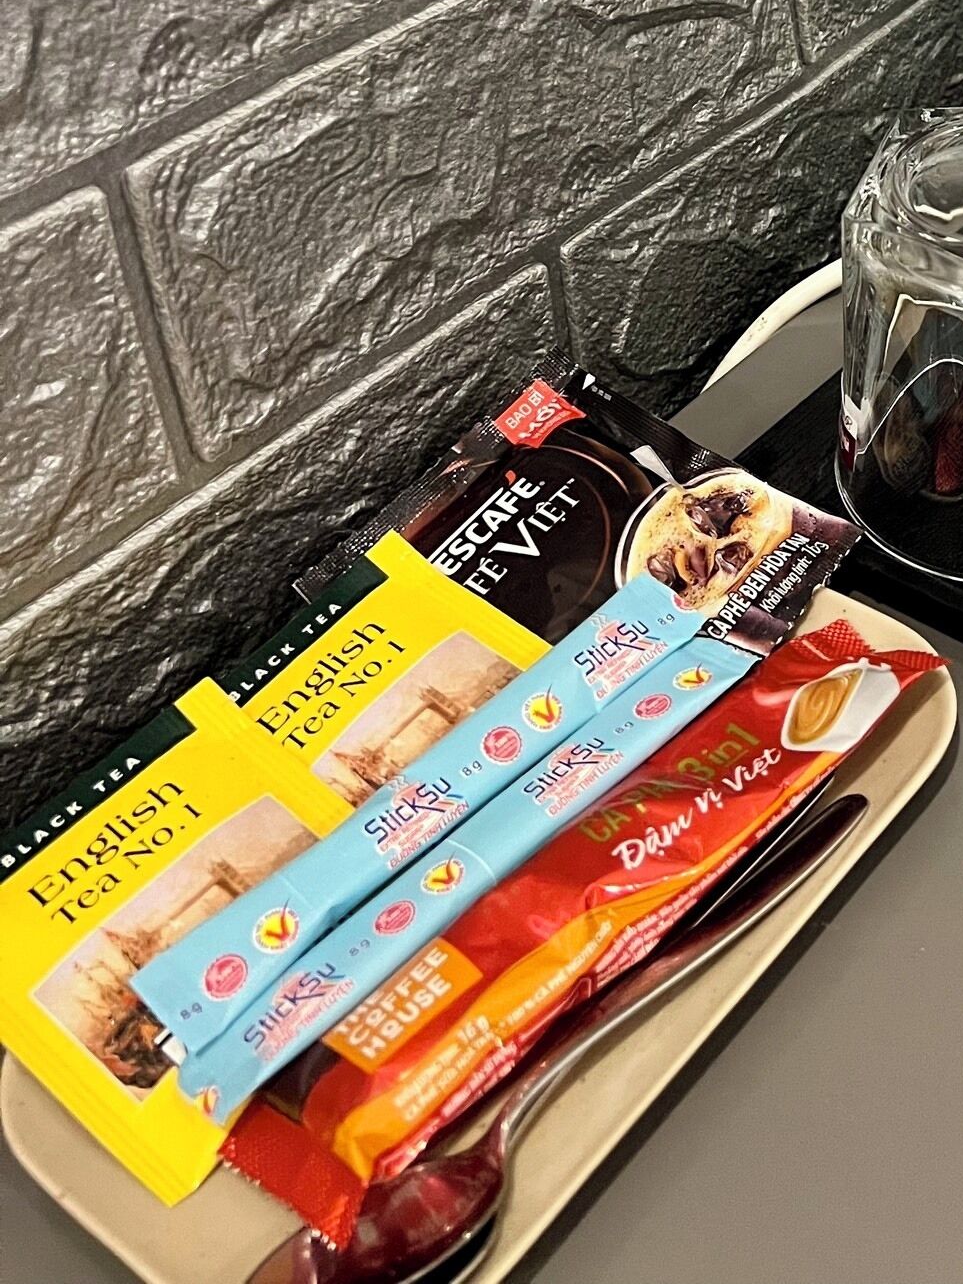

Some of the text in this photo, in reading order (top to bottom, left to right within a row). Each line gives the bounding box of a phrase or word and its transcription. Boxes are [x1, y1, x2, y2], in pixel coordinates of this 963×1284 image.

[505, 404, 532, 429] BAO
[427, 470, 541, 576] ESCAFÉ
[780, 532, 811, 558] TAN
[463, 556, 508, 595] FÉ
[229, 603, 341, 702] BLACK TEA
[256, 622, 387, 735] English
[281, 701, 341, 749] Tea
[1, 757, 141, 867] BLACK TEA
[27, 782, 184, 907] English
[611, 807, 693, 870] Đậm
[722, 748, 782, 793] Việt
[51, 873, 122, 924] Tea
[349, 947, 449, 1045] COFFEE
[361, 973, 452, 1059] HOUSE
